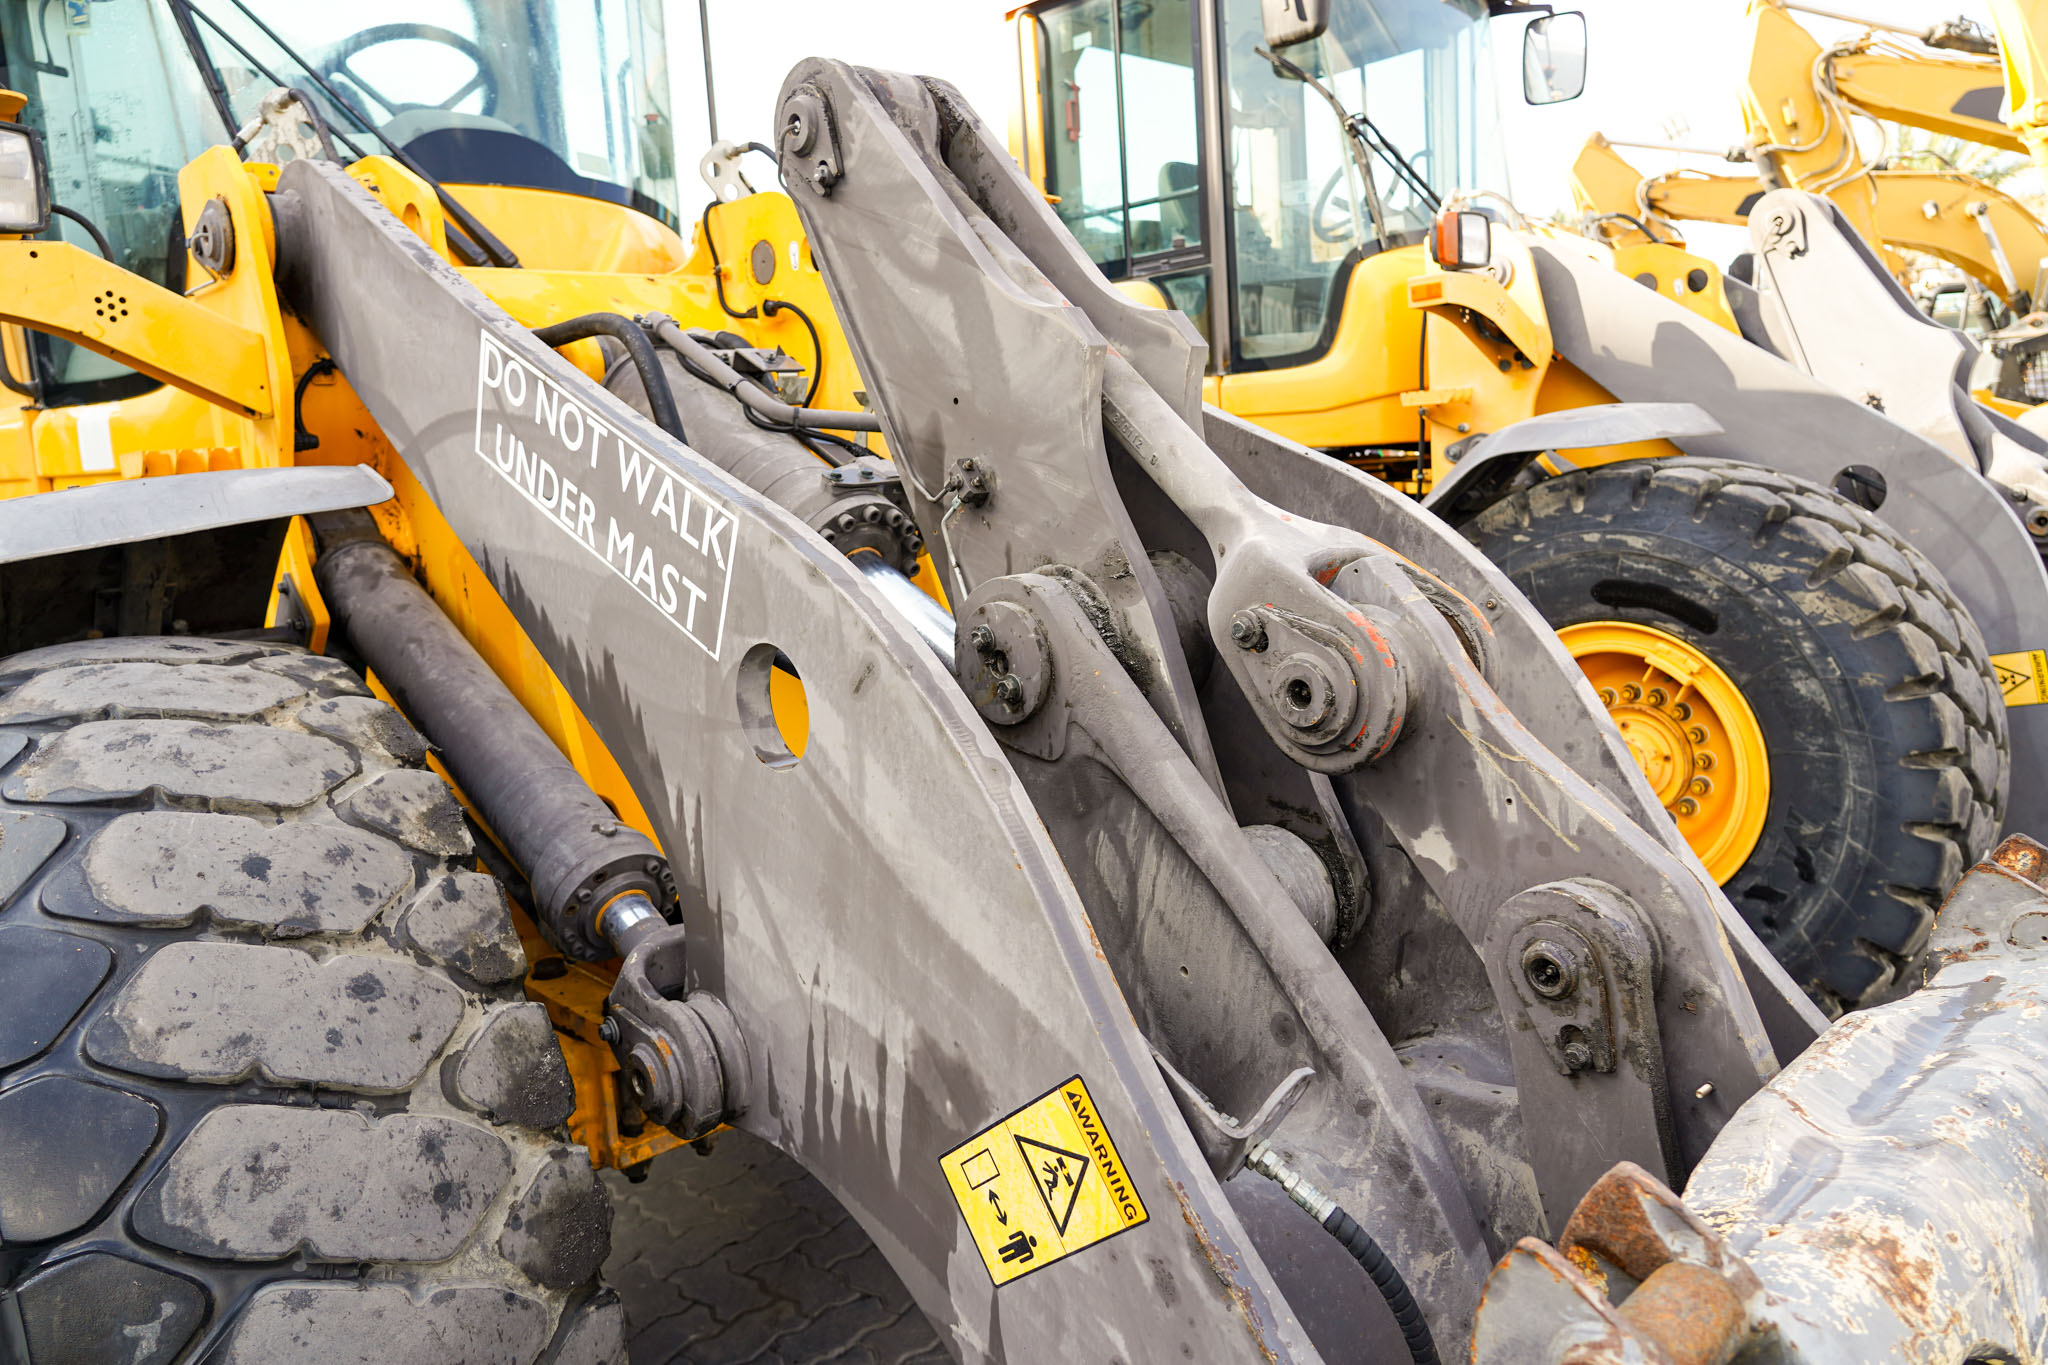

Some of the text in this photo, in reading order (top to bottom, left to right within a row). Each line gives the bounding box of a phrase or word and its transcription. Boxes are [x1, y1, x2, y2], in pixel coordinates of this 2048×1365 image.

[483, 338, 730, 571] DO NOT WALK
[495, 423, 707, 633] UNDER MAST
[1077, 1106, 1137, 1221] WARNING
